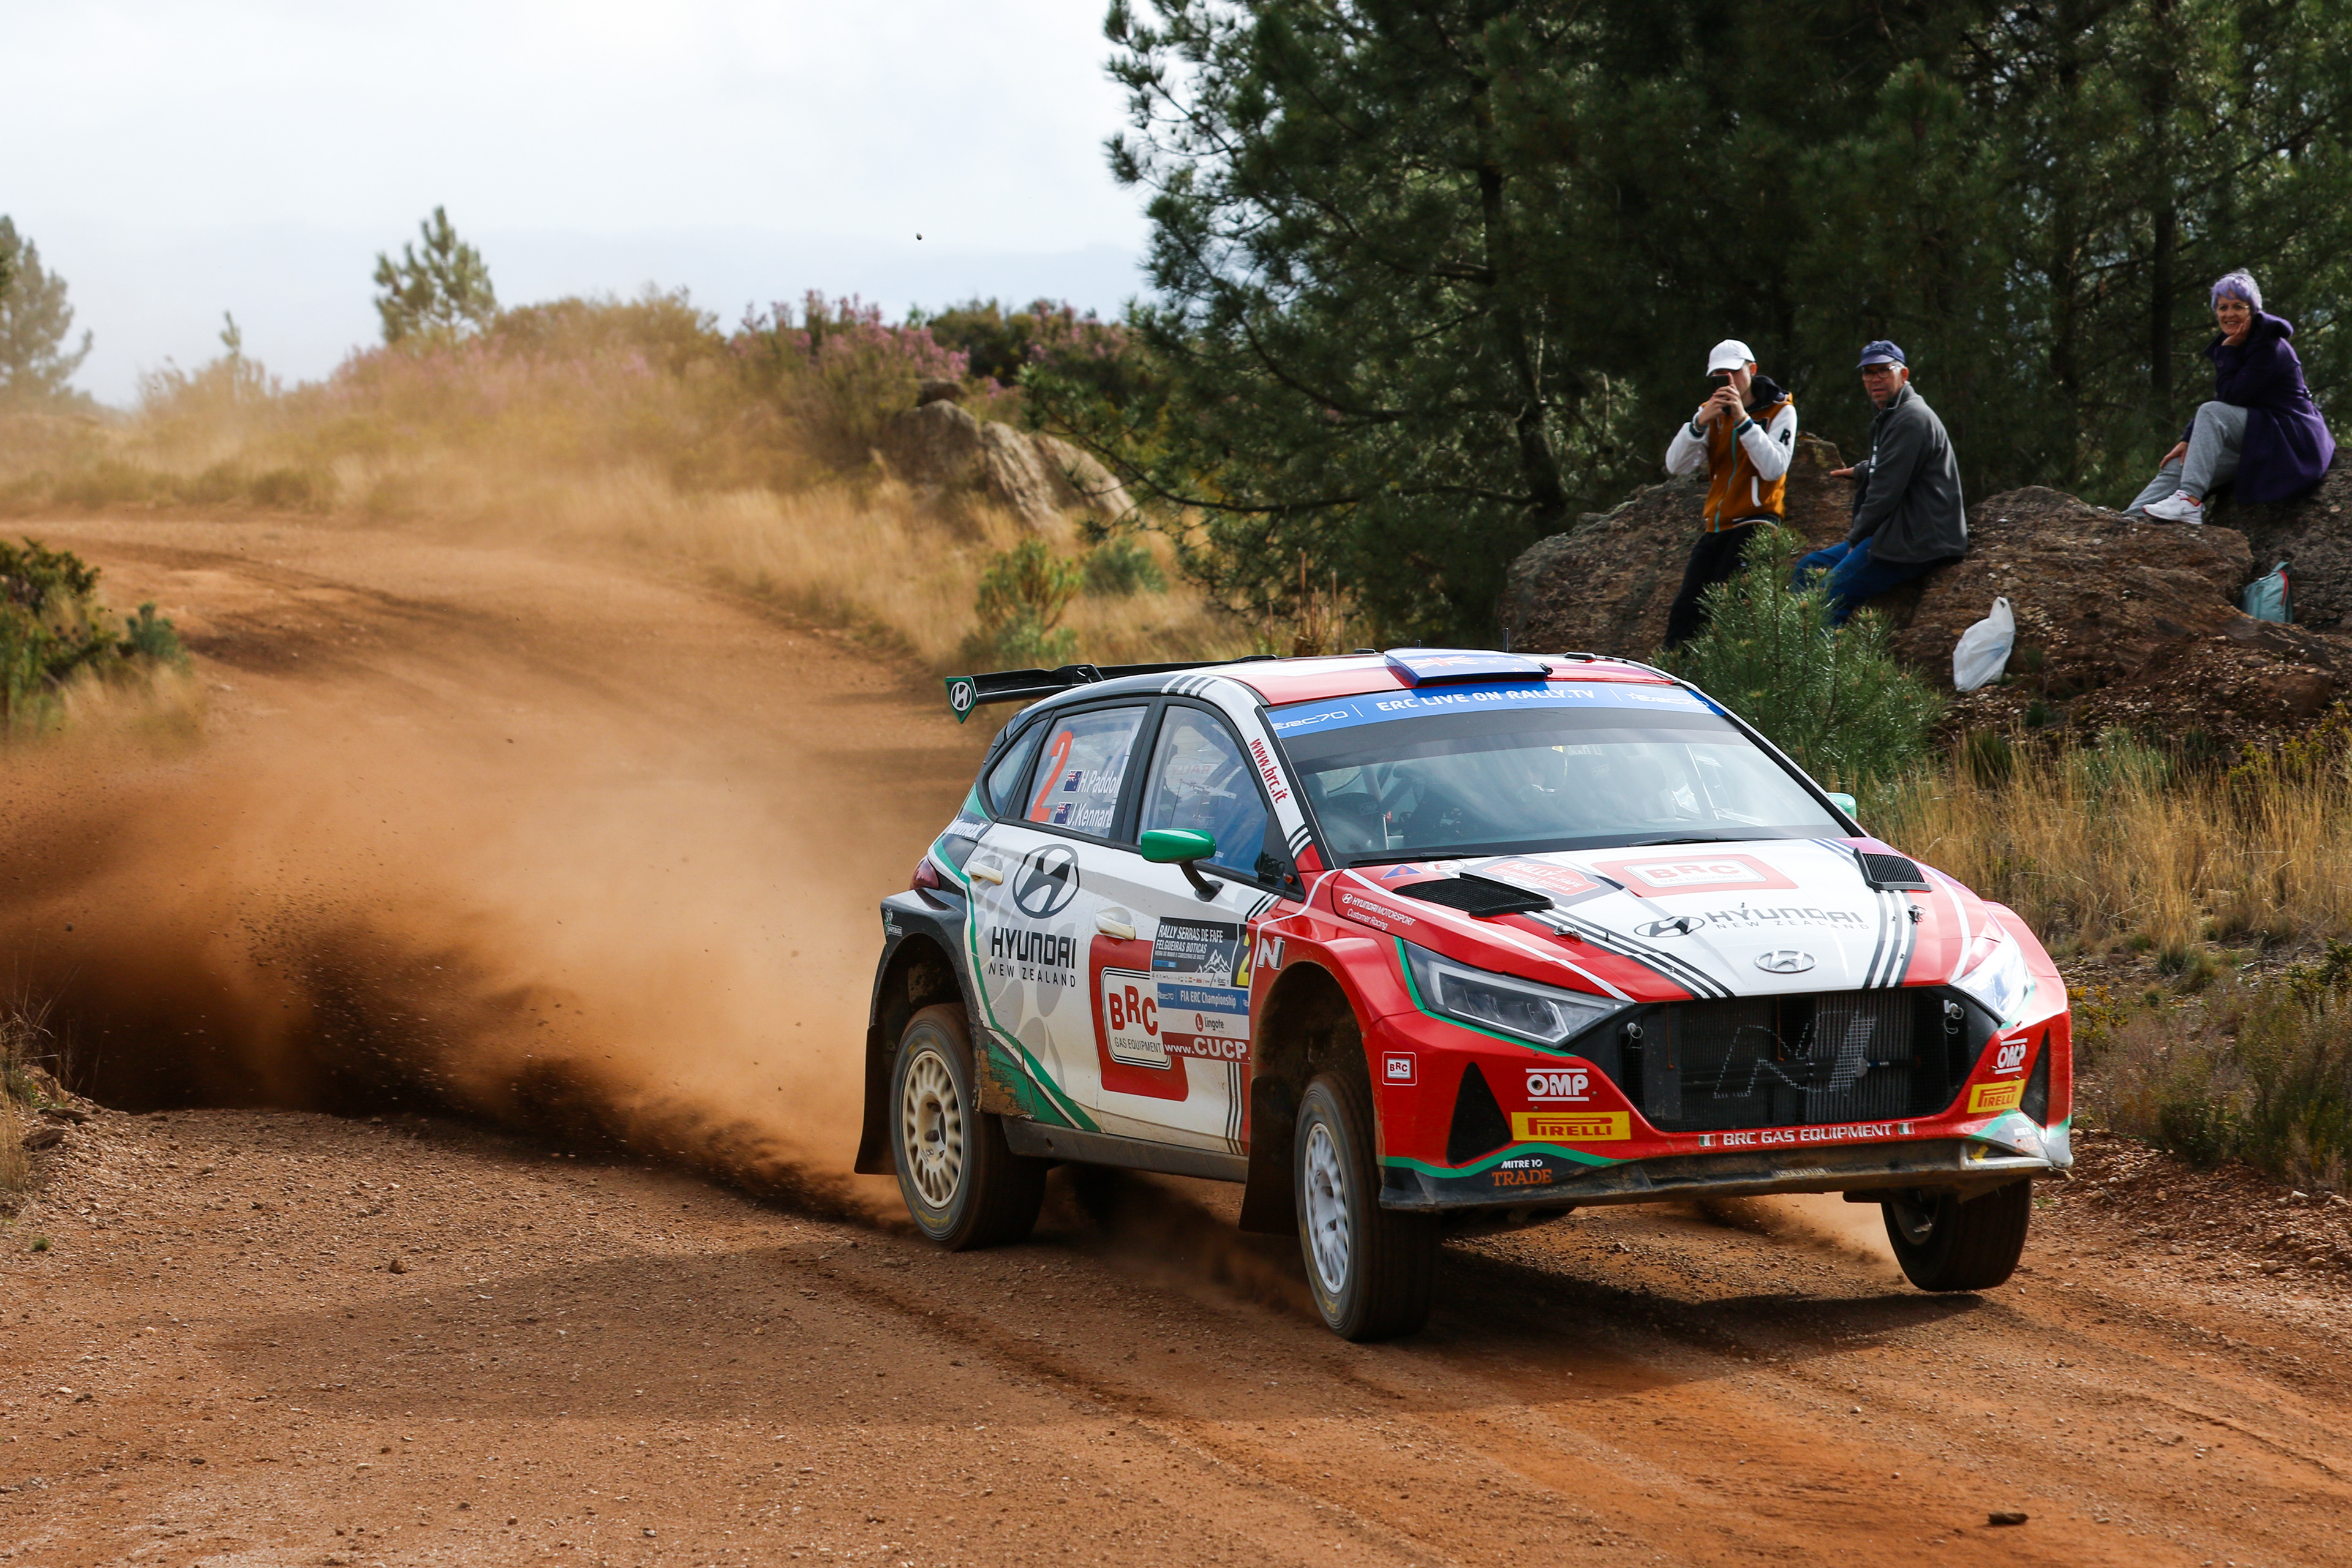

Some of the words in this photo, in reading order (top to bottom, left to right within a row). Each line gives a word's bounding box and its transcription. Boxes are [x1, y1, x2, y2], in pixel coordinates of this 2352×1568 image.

[1779, 428, 1791, 446] R
[1376, 698, 1419, 712] ERC
[1422, 693, 1466, 706] LIVE
[1472, 691, 1503, 701] ON
[1505, 689, 1595, 699] RALLY.TV
[1030, 731, 1073, 822] 2
[1250, 739, 1287, 804] www.brc.it
[1507, 862, 1555, 877] RALLY
[1644, 865, 1740, 879] BRC
[1347, 908, 1371, 922] Customer
[1370, 916, 1389, 930] Racing
[1704, 908, 1864, 922] HYUNDAI
[1158, 925, 1178, 939] RALLY
[1177, 926, 1199, 941] SERRAS
[1201, 929, 1208, 941] DE
[1210, 930, 1223, 943] FAFE
[1774, 921, 1869, 929] ZEALAND
[991, 926, 1077, 969] HYUNDAI
[1156, 940, 1185, 952] FELGUEIRAS
[1186, 943, 1208, 954] BOTICAS
[989, 962, 1014, 978] NEW
[1022, 967, 1076, 987] ZEALAND
[1190, 991, 1200, 1003] ERC
[1202, 992, 1236, 1009] Championship
[1109, 985, 1158, 1036] BRC
[1115, 1037, 1127, 1049] GAS
[1128, 1039, 1161, 1053] EQUIPMENT
[1997, 1044, 2026, 1068] OMP
[1390, 1062, 1408, 1072] BRC
[1526, 1074, 1589, 1096] OMP
[1977, 1086, 2017, 1107] PIRELLI
[1528, 1117, 1613, 1136] PIRELLI
[1723, 1133, 1757, 1145] BRC
[1761, 1130, 1795, 1144] GAS
[1800, 1124, 1892, 1141] EQUIPMENT
[1501, 1159, 1529, 1169] MITRE
[1531, 1159, 1543, 1167] 10
[1491, 1169, 1553, 1186] TRADE
